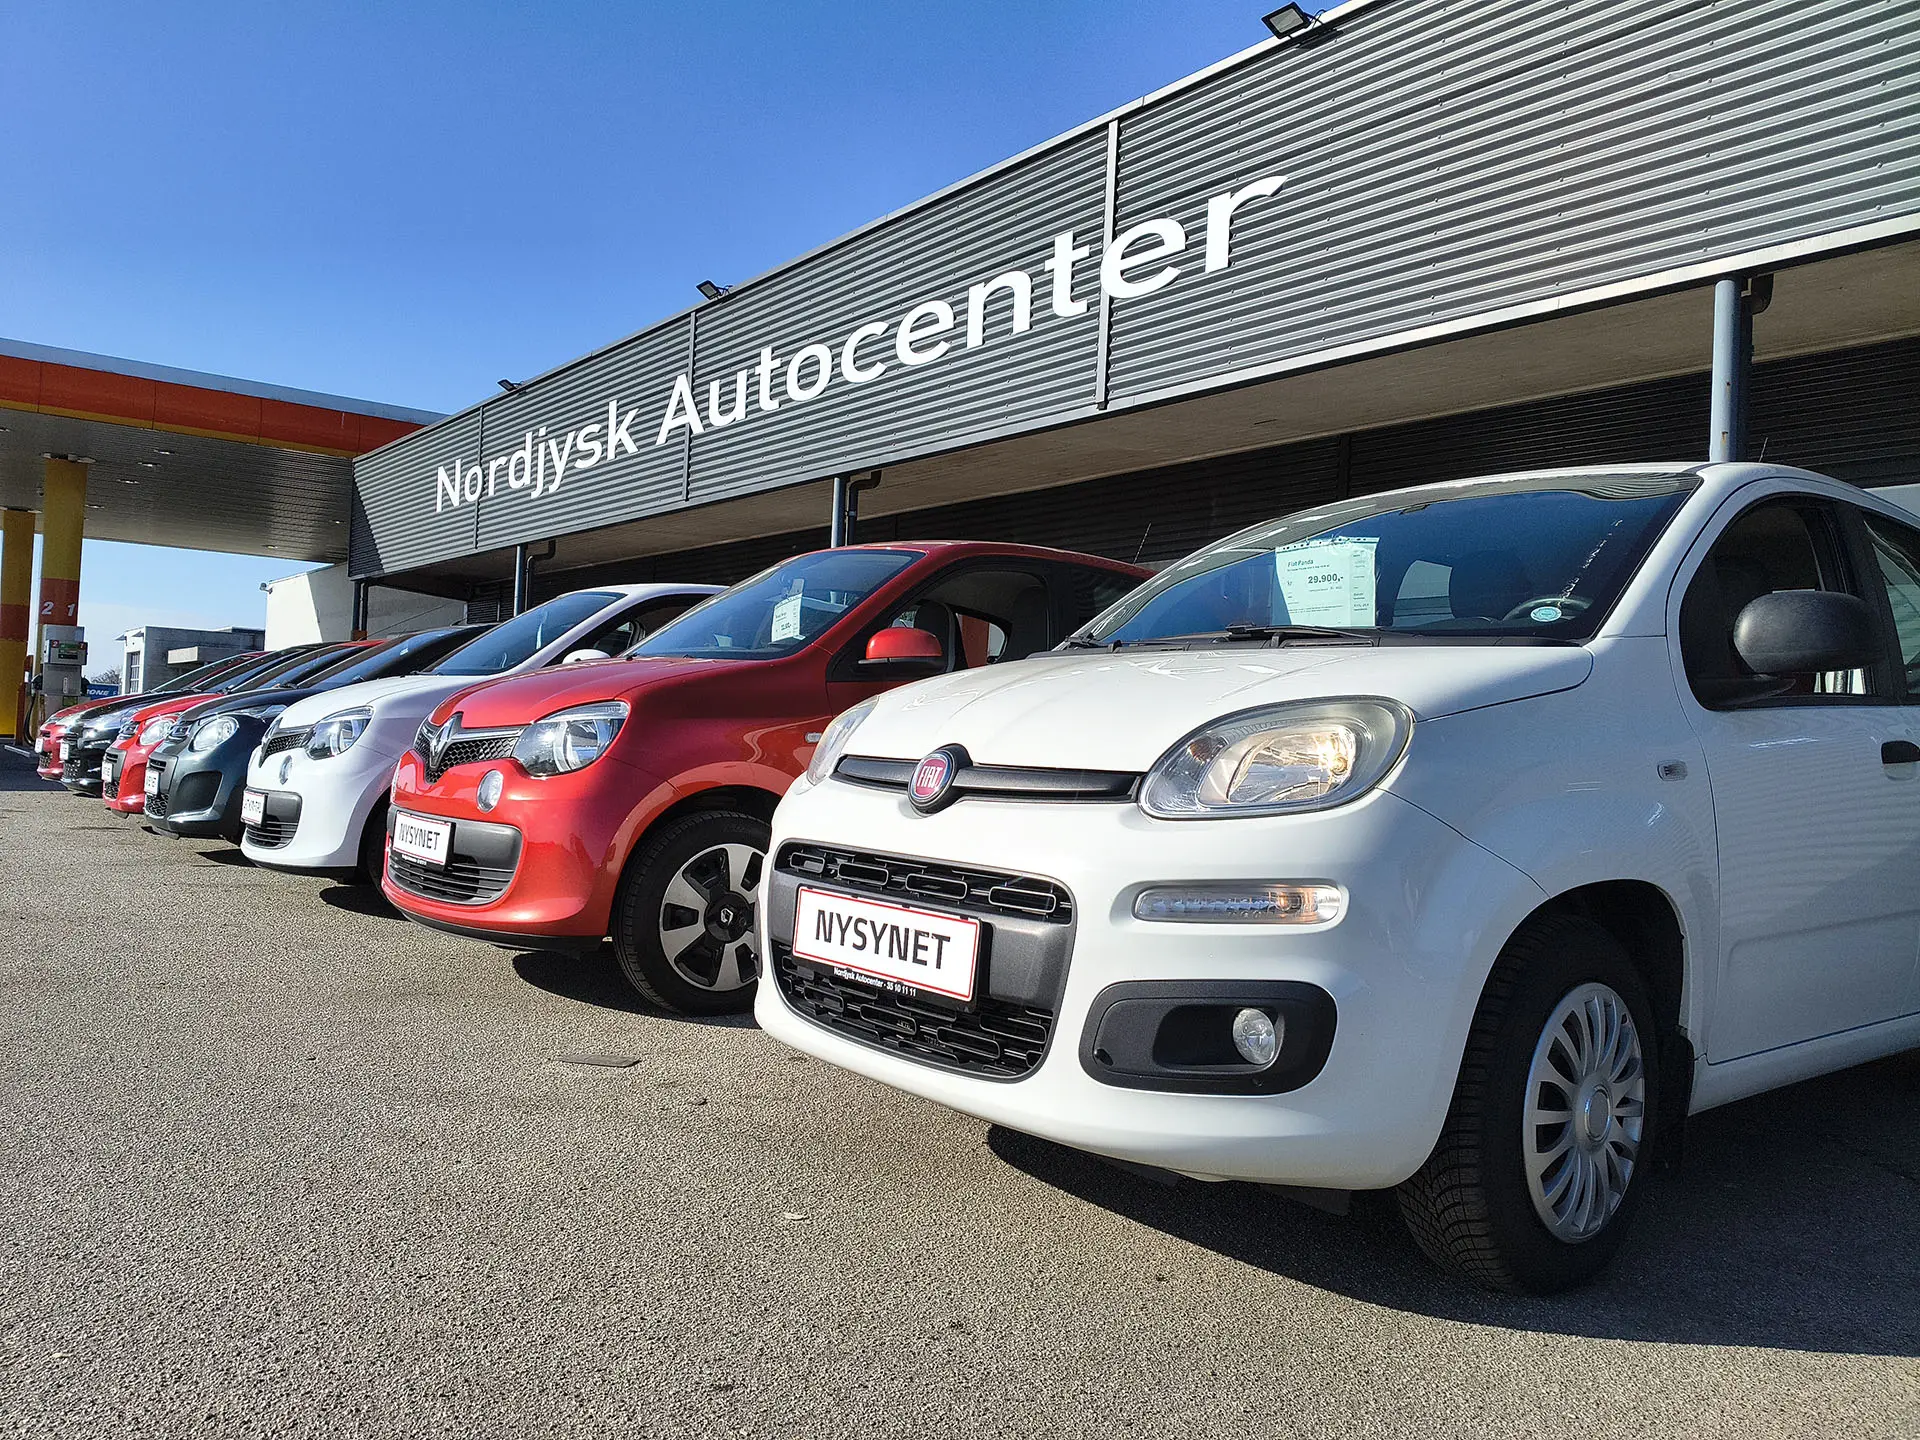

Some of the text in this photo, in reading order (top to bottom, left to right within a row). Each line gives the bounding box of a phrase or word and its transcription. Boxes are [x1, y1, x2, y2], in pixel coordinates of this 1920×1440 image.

[435, 174, 1288, 513] Nordjysk Autocenter
[1307, 573, 1344, 584] 29.900,-
[41, 601, 75, 617] 2 1
[916, 765, 943, 788] FIAT
[398, 823, 441, 850] NYSYNET
[815, 909, 951, 970] NYSYNET
[833, 967, 855, 980] Nordjysk
[855, 973, 884, 988] Autocenter
[886, 981, 894, 991] 35
